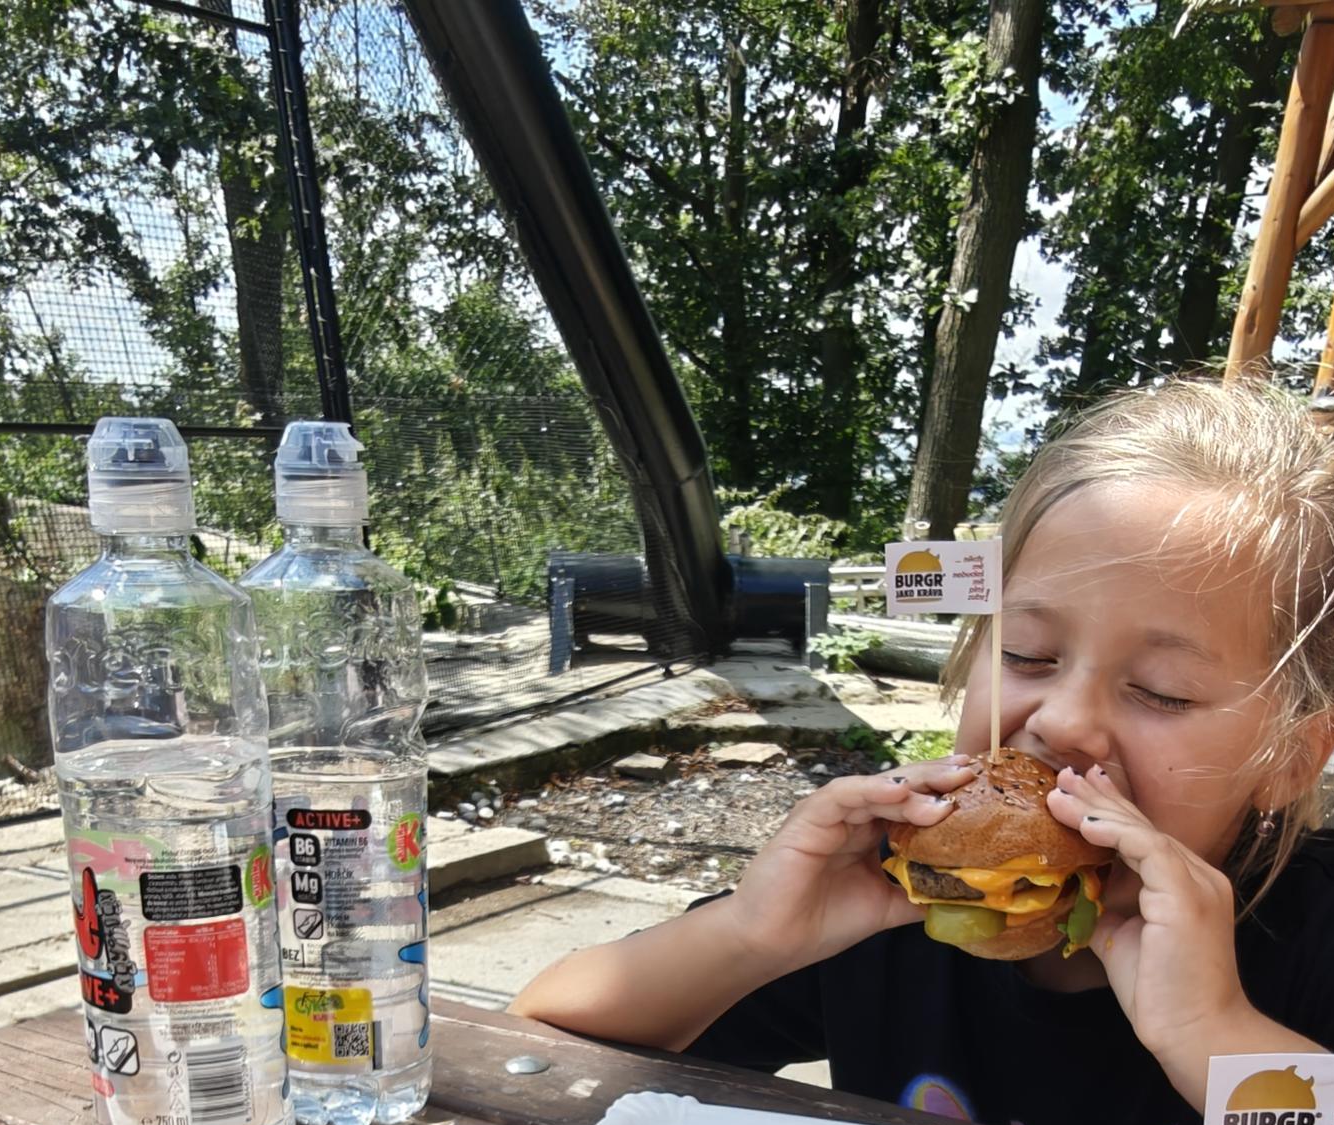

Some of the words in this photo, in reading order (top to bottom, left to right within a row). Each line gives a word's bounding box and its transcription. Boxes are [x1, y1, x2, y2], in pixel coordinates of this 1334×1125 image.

[895, 573, 943, 589] BURGR
[895, 590, 915, 599] JAKO
[295, 812, 361, 828] ACTIVE+
[294, 837, 316, 856] B6
[294, 873, 318, 895] Mg
[282, 948, 300, 962] BEZ
